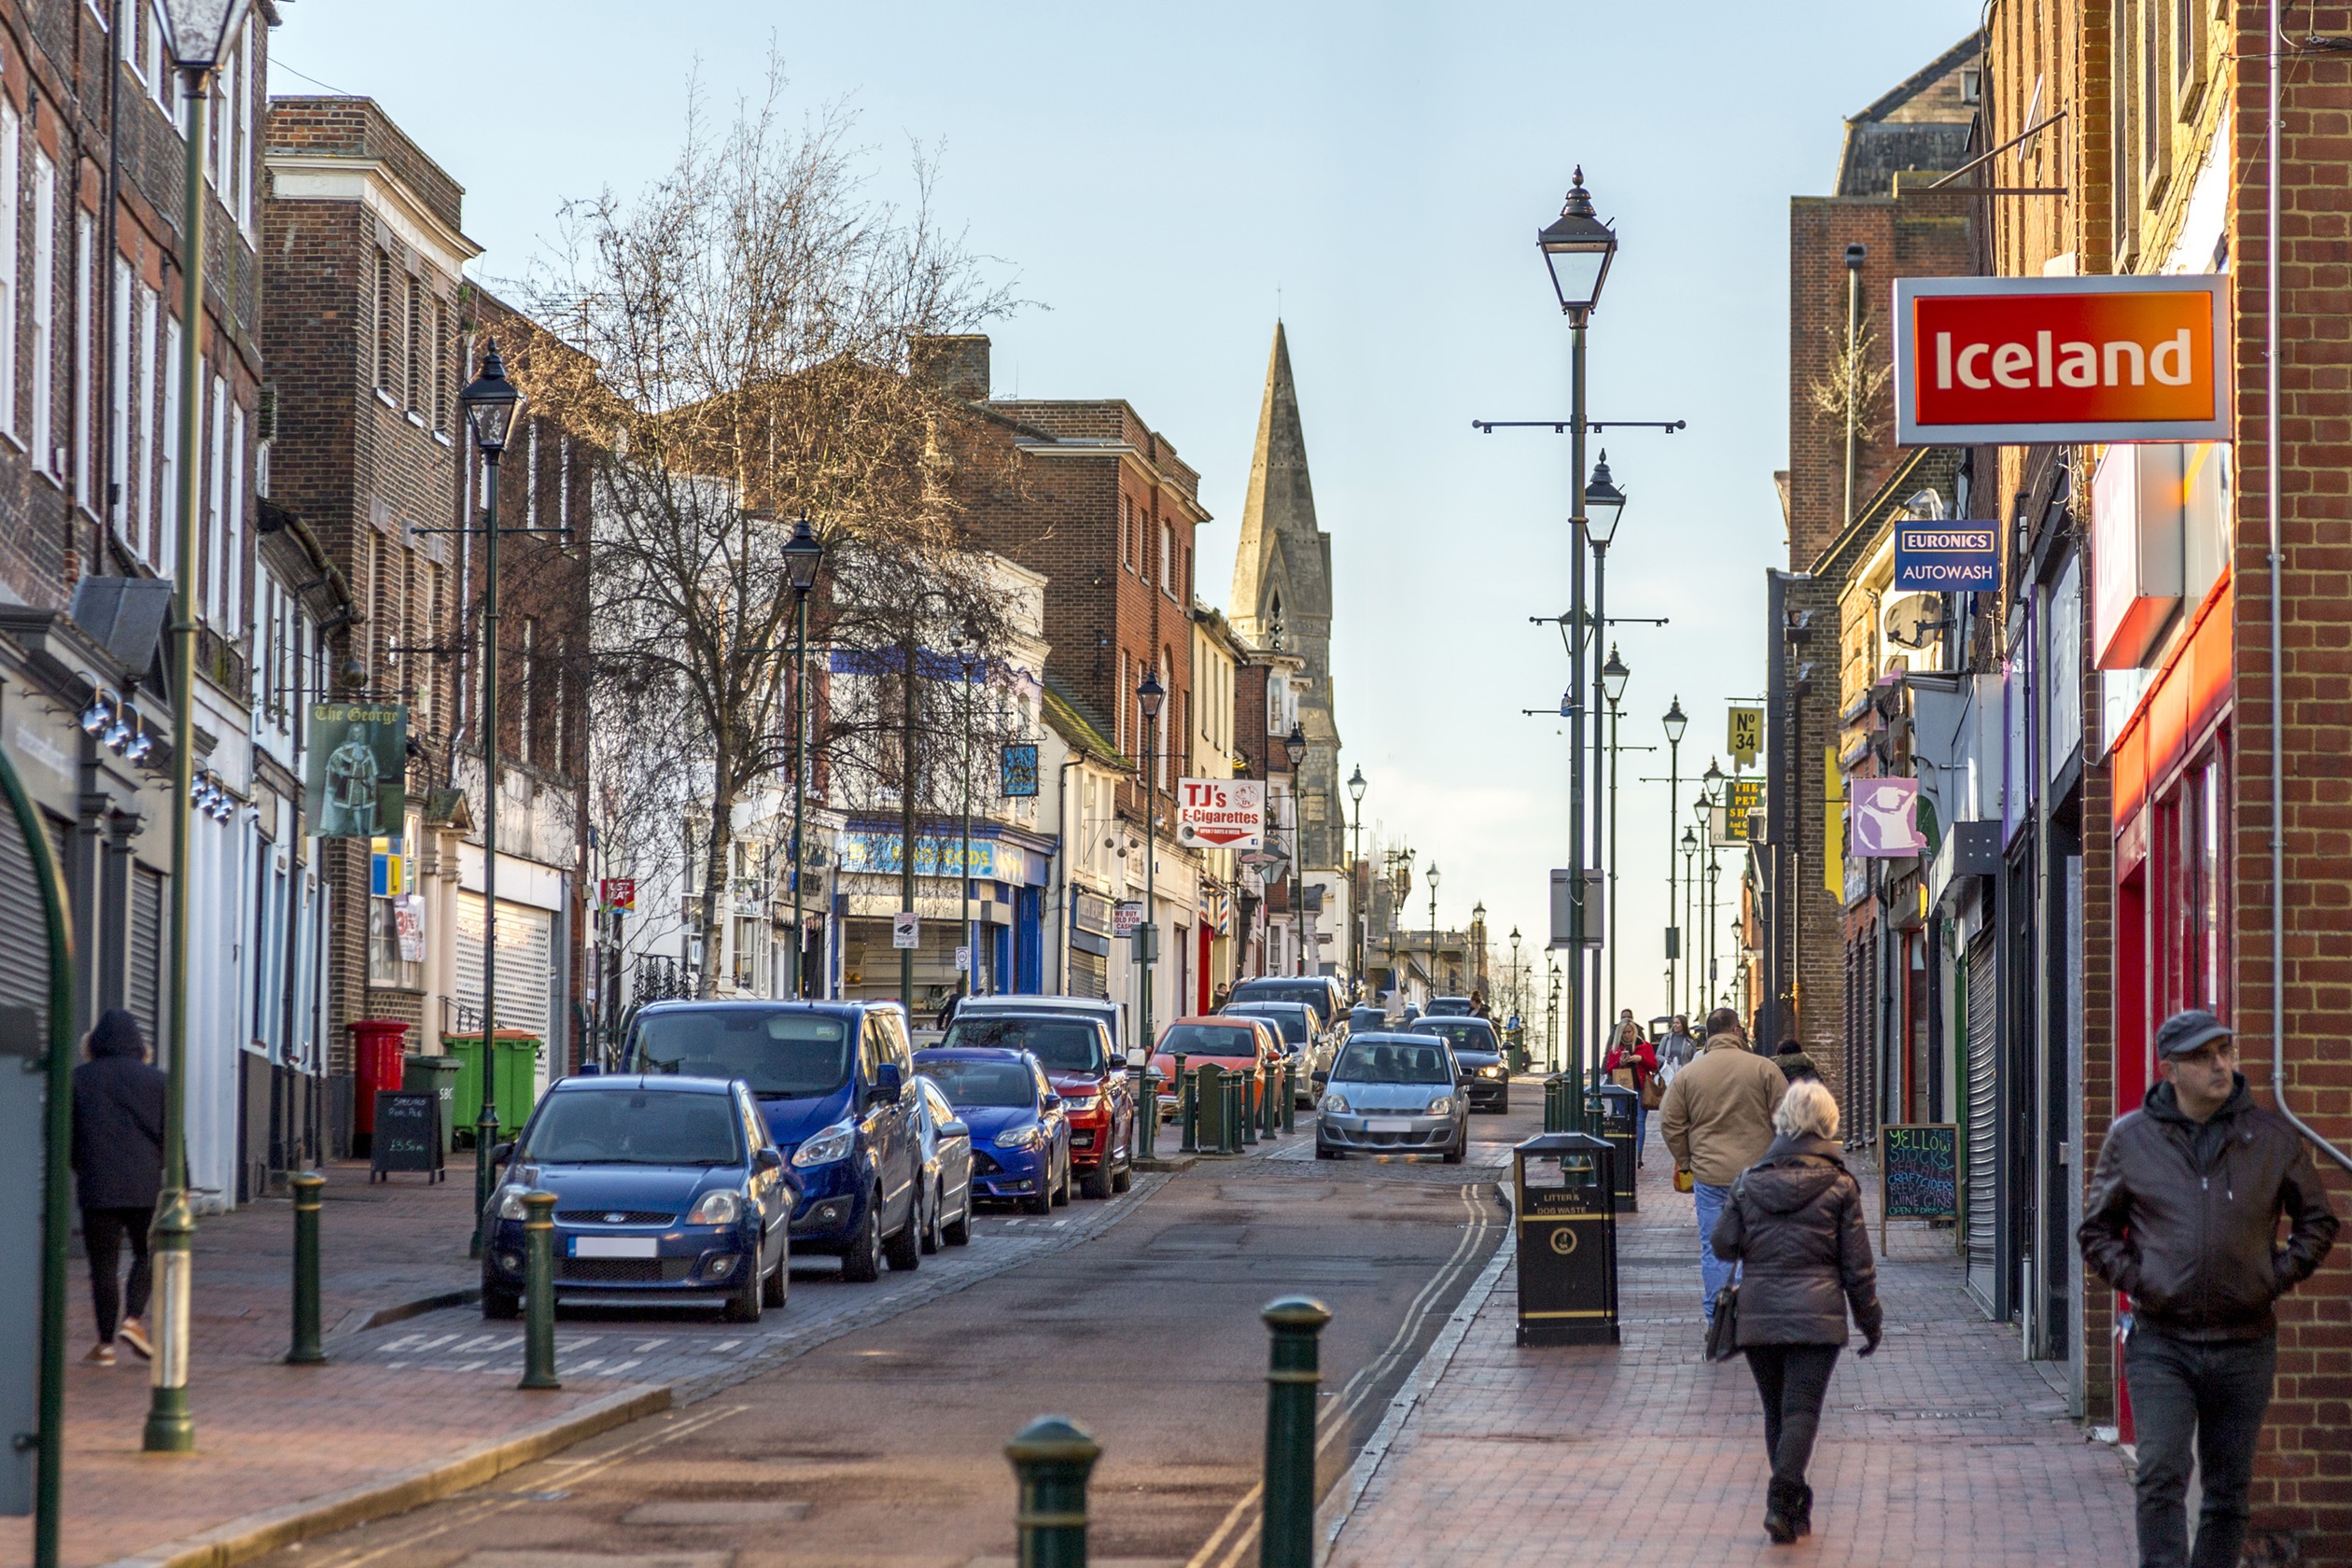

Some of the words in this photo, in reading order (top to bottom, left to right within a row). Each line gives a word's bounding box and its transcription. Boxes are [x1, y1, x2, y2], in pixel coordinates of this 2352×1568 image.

[1936, 329, 2191, 390] Iceland
[1908, 535, 1987, 548] EURONICS
[1903, 566, 1993, 580] AUTOWASH
[315, 706, 343, 722] The
[346, 707, 399, 724] George
[1735, 733, 1756, 750] 34
[1184, 784, 1227, 807] TJ's
[1734, 783, 1758, 792] THE
[1735, 795, 1757, 805] PET
[1183, 808, 1259, 825] E-Cigarettes
[1889, 1129, 1951, 1152] YELLOW
[1932, 1128, 1953, 1142] THE
[1889, 1148, 1949, 1168] STOCKS
[1890, 1160, 1920, 1174] REAL
[1921, 1164, 1953, 1181] ALES
[1887, 1172, 1923, 1185] CRAFT
[1921, 1177, 1954, 1192] CIDERS
[1544, 1194, 1573, 1202] LITTER
[1890, 1183, 1916, 1195] BEER
[1916, 1185, 1954, 1199] GARDEN
[1891, 1196, 1920, 1207] WINE
[1889, 1206, 1911, 1215] OPEN
[1920, 1206, 1939, 1214] DAYS
